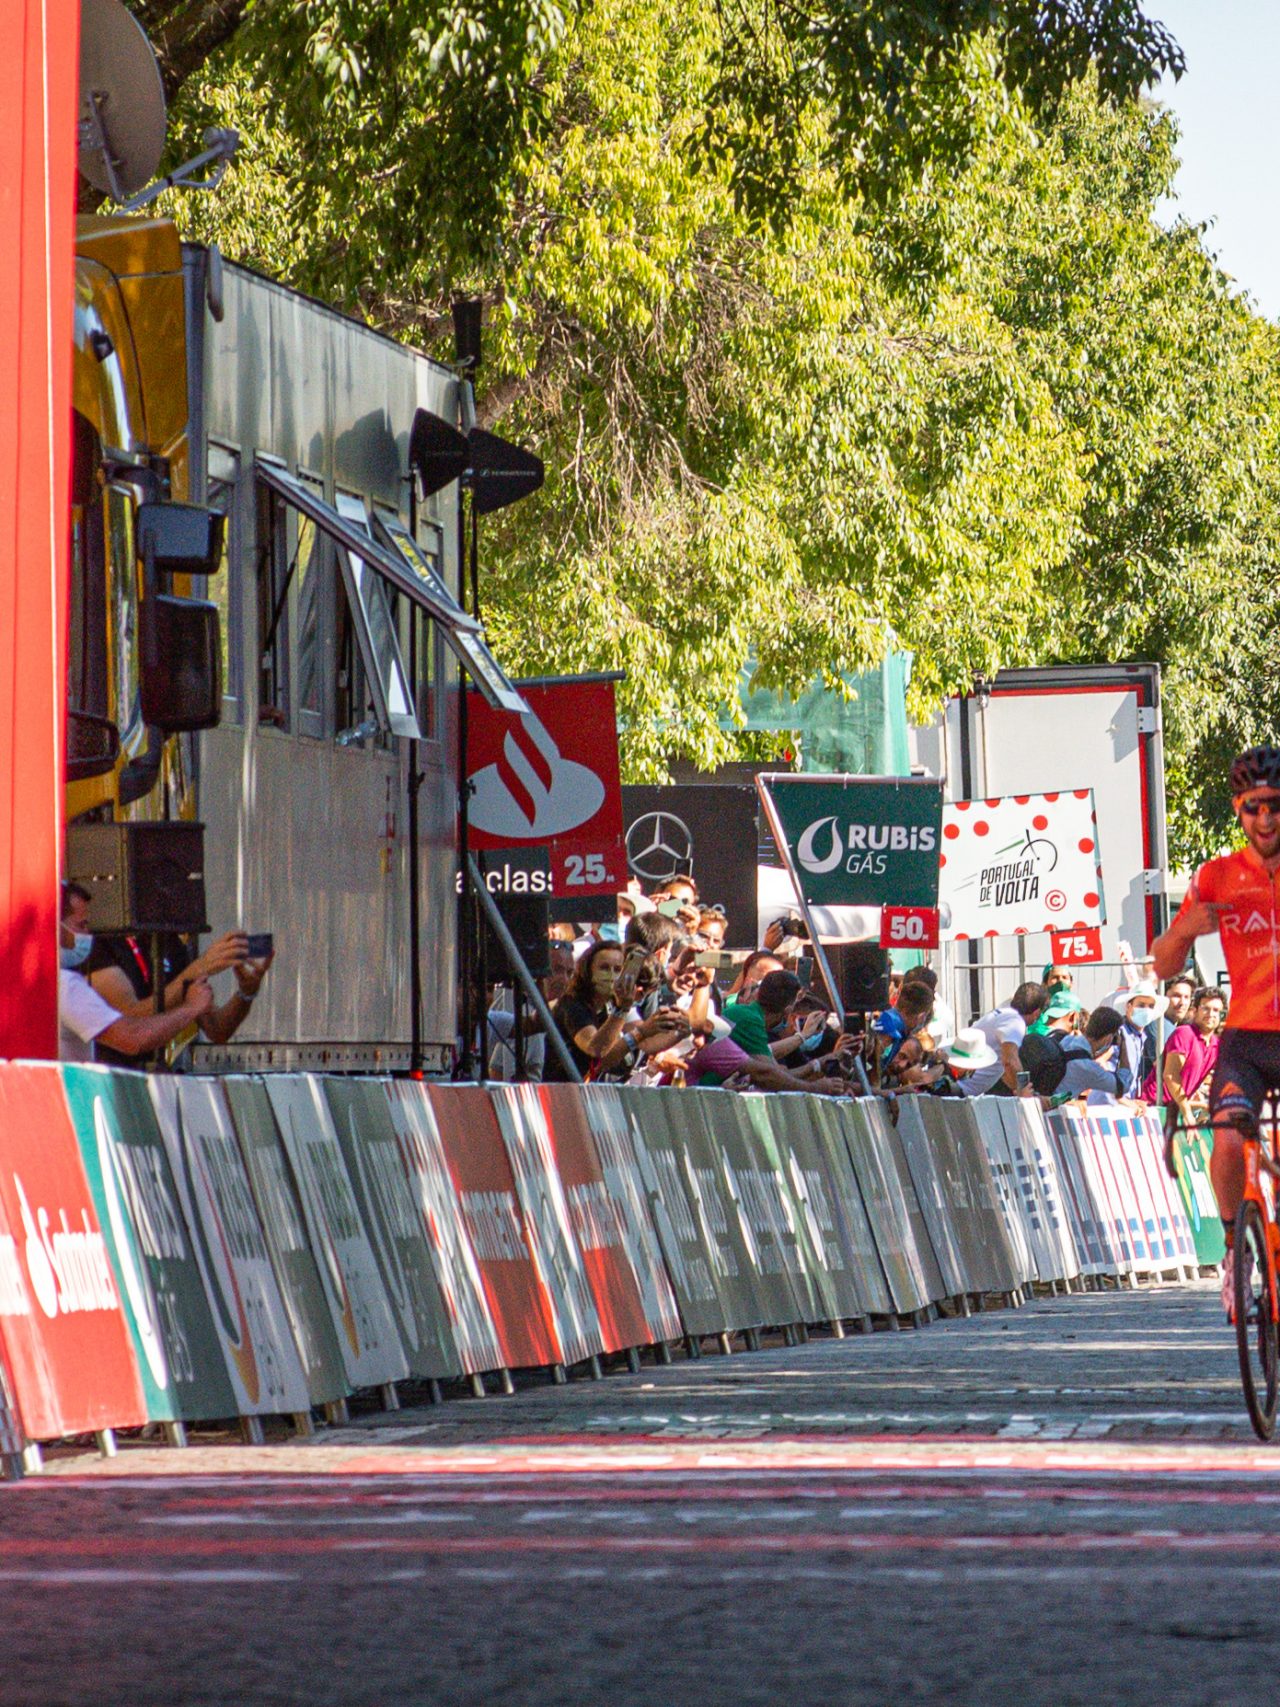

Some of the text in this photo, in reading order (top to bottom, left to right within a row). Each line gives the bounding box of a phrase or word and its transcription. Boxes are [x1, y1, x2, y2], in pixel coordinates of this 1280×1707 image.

[846, 851, 888, 875] GÁS
[980, 859, 1034, 886] PORTUGAL
[980, 876, 1039, 907] DE VOLTA
